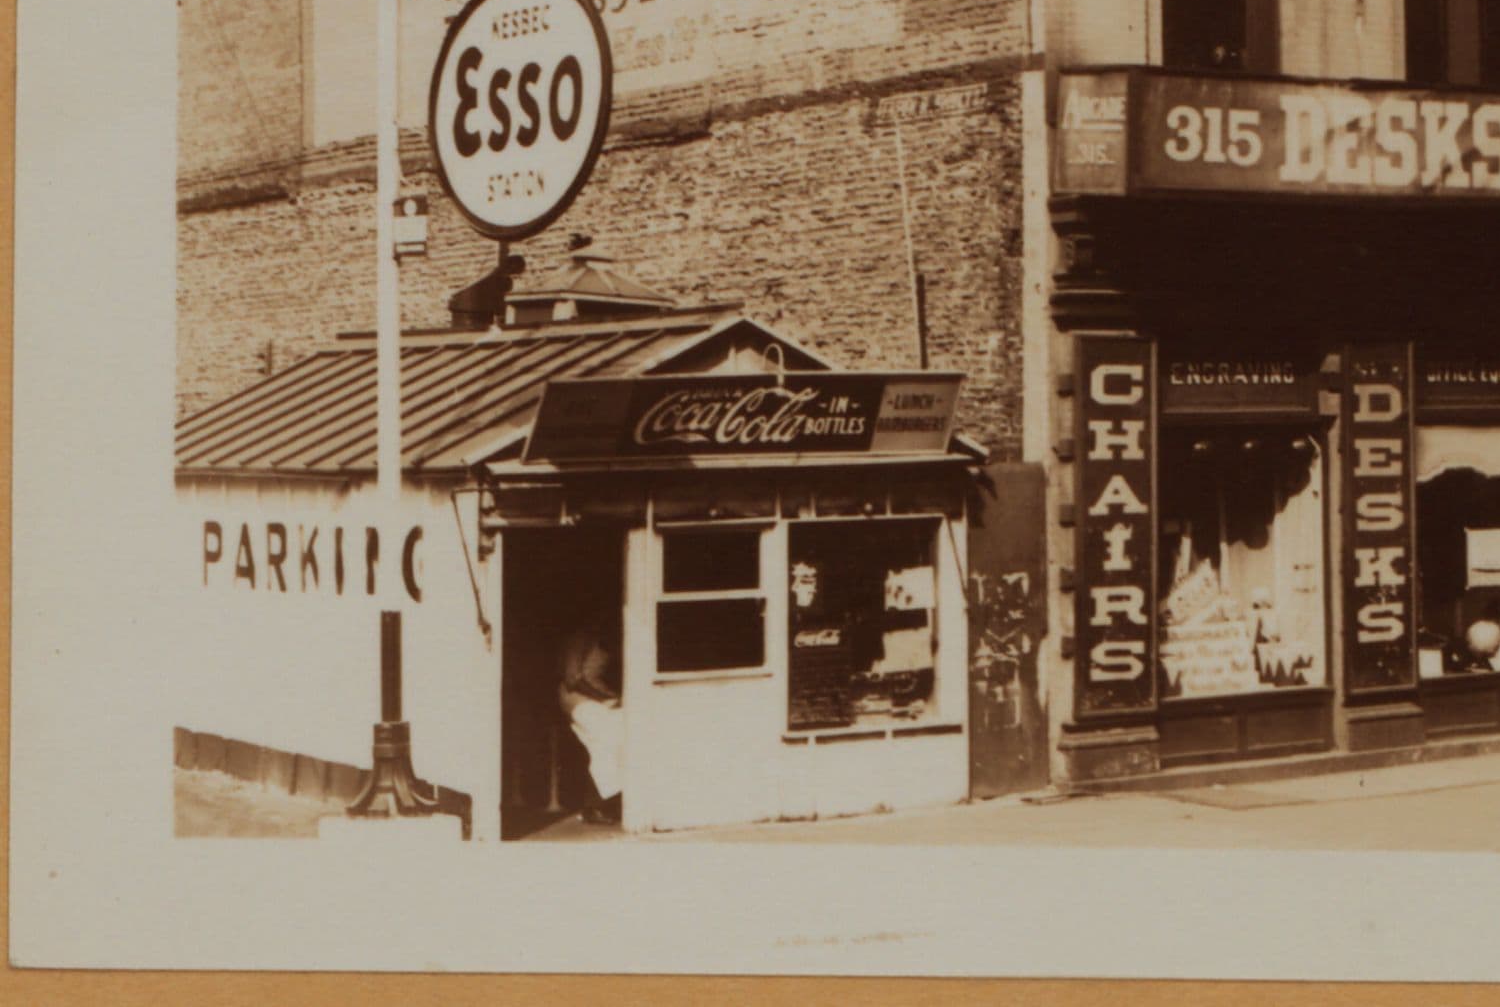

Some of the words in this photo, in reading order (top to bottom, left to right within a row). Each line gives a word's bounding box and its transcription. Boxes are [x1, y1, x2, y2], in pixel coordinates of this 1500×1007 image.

[1164, 105, 1263, 167] 315
[487, 170, 545, 203] STATION
[1170, 362, 1296, 385] ENGRAVING
[633, 387, 821, 445] Coca-Cola
[803, 416, 865, 436] BOTTLES
[1088, 363, 1147, 683] CHAIRS
[1353, 384, 1405, 644] DESKS
